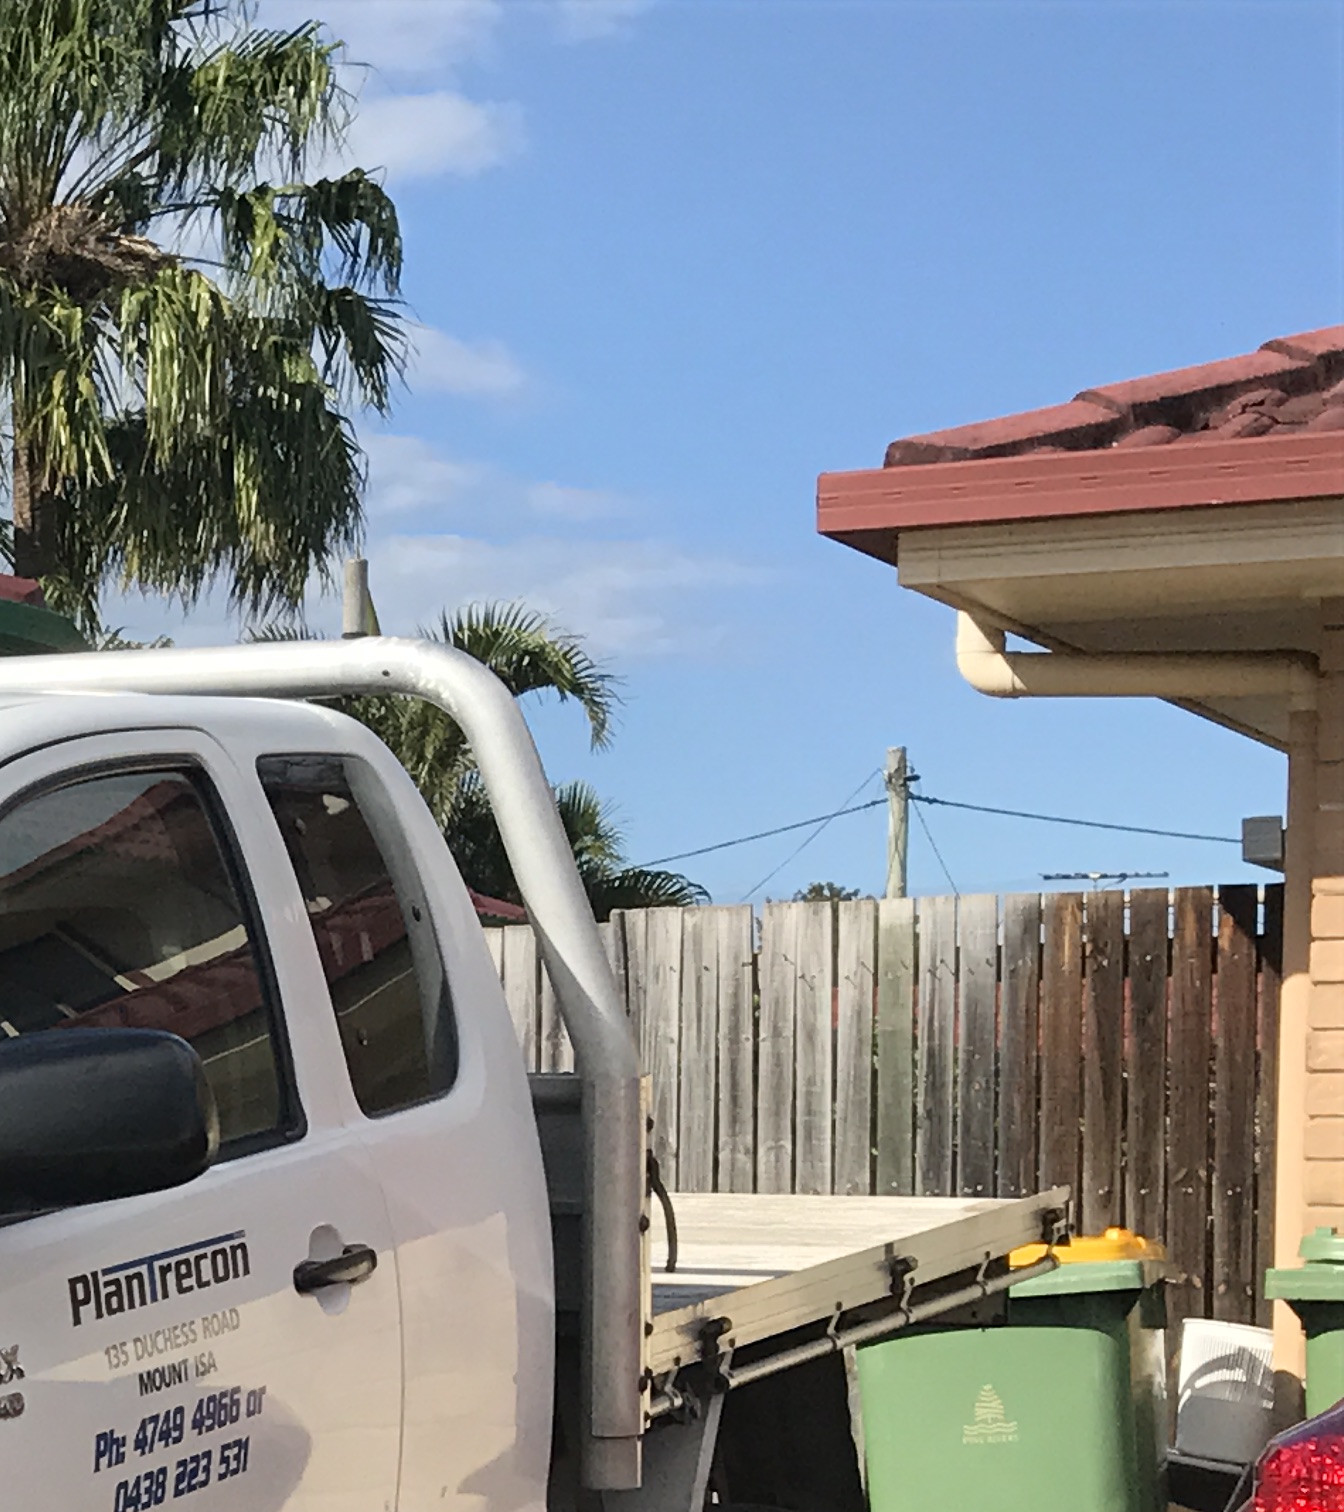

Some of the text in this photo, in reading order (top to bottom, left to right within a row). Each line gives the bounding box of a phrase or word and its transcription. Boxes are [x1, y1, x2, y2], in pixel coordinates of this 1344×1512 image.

[105, 1308, 240, 1371] 135 DUCHESS ROAD
[138, 1351, 218, 1396] MOUNT ISA
[133, 1405, 185, 1457] 4749
[191, 1386, 241, 1436] 4966
[246, 1386, 267, 1418] or
[173, 1449, 212, 1498] 223
[217, 1435, 250, 1481] 531
